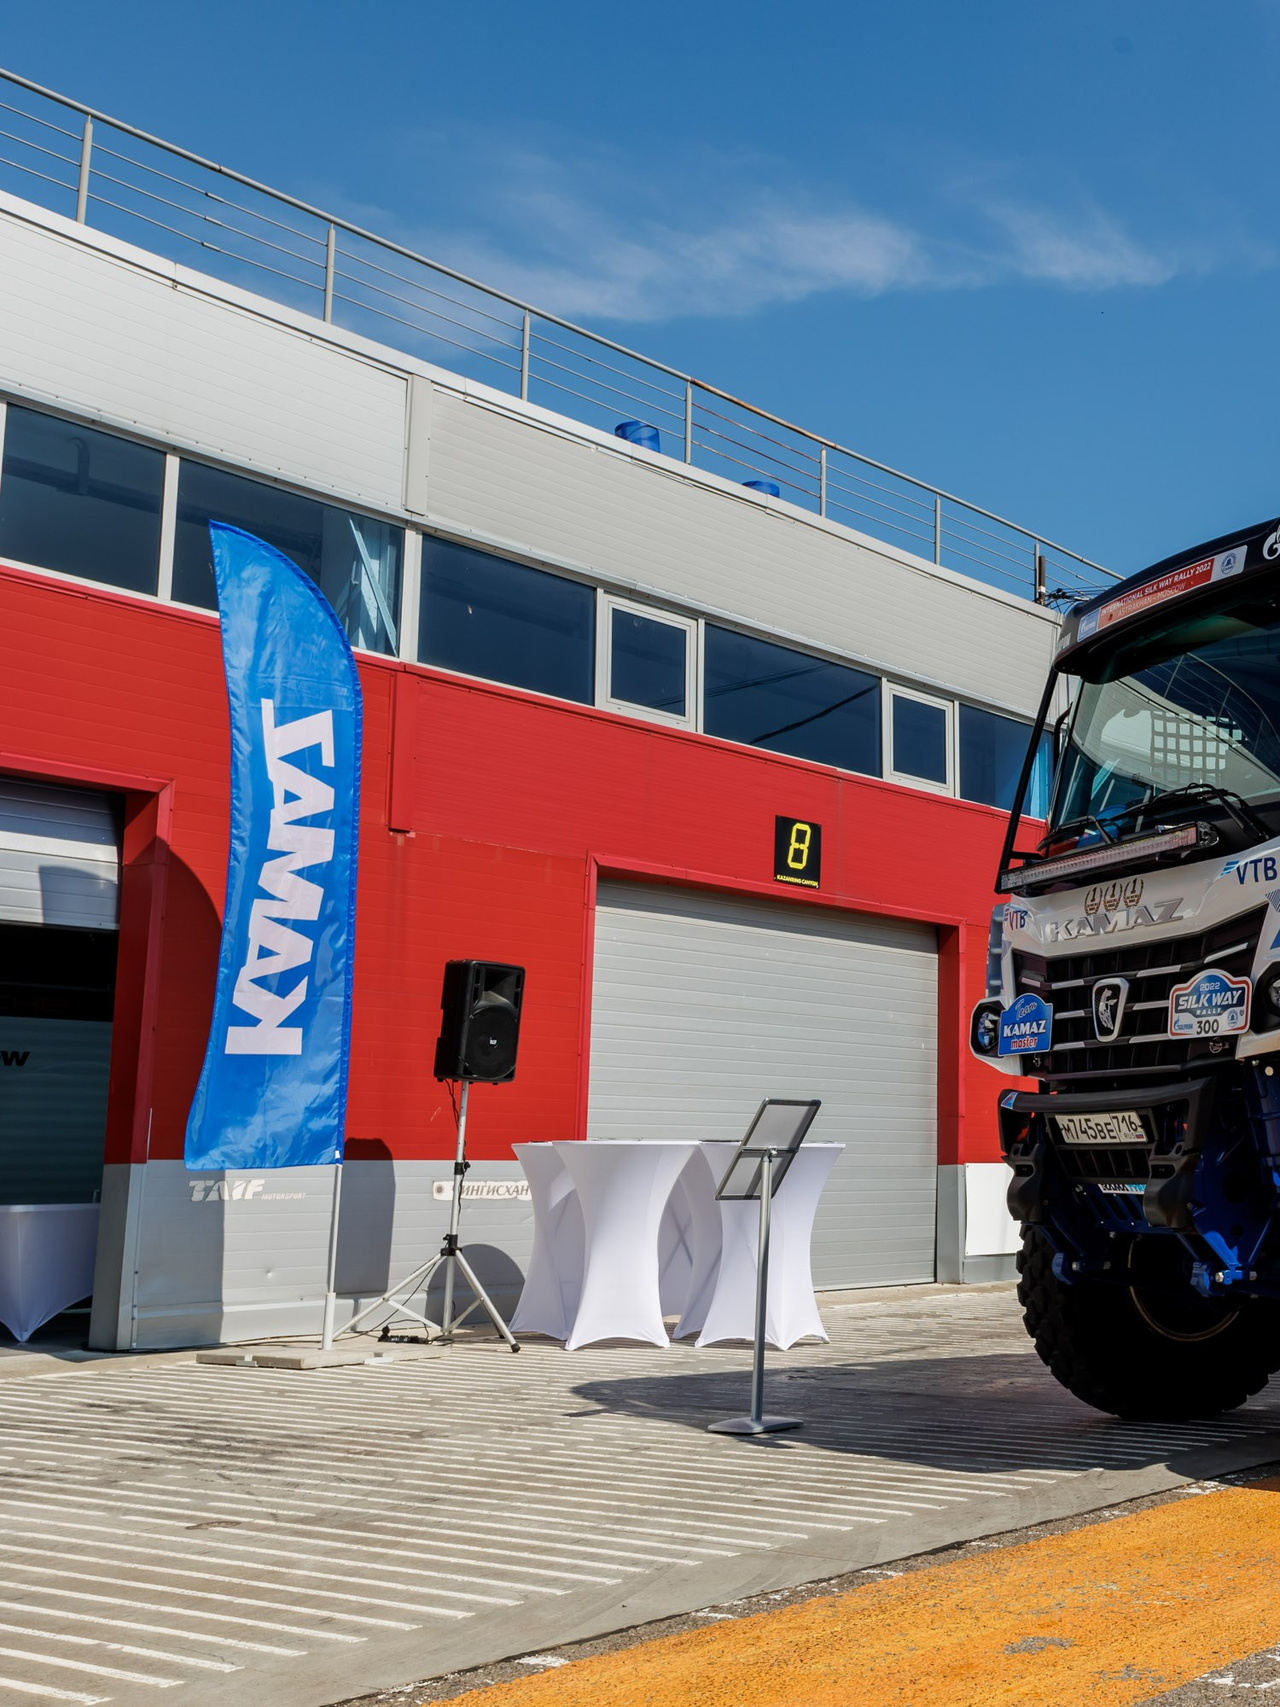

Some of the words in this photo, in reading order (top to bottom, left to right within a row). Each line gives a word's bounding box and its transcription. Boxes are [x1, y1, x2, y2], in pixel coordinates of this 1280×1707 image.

[1101, 592, 1144, 616] INTERNATIONAL
[1144, 584, 1158, 596] SILK
[1158, 577, 1172, 589] WAY
[1174, 570, 1194, 584] RALLY
[1195, 562, 1212, 575] 2022
[1118, 599, 1152, 617] ASTRAKHAN
[1157, 582, 1186, 598] MOSCOW
[787, 823, 811, 869] 8
[1235, 858, 1278, 885] VTB
[1008, 910, 1028, 930] VTB
[1050, 898, 1184, 942] KAMAZ
[1200, 982, 1220, 991] 2022
[1015, 999, 1038, 1021] Team
[1177, 994, 1210, 1010] SILK
[1212, 990, 1242, 1006] WAY
[1003, 1020, 1046, 1038] KAMAZ
[1196, 1019, 1219, 1035] 300
[1011, 1036, 1038, 1050] master
[262, 1192, 306, 1200] MOTORSPORT
[460, 1184, 530, 1196] ИНГИСХАН
